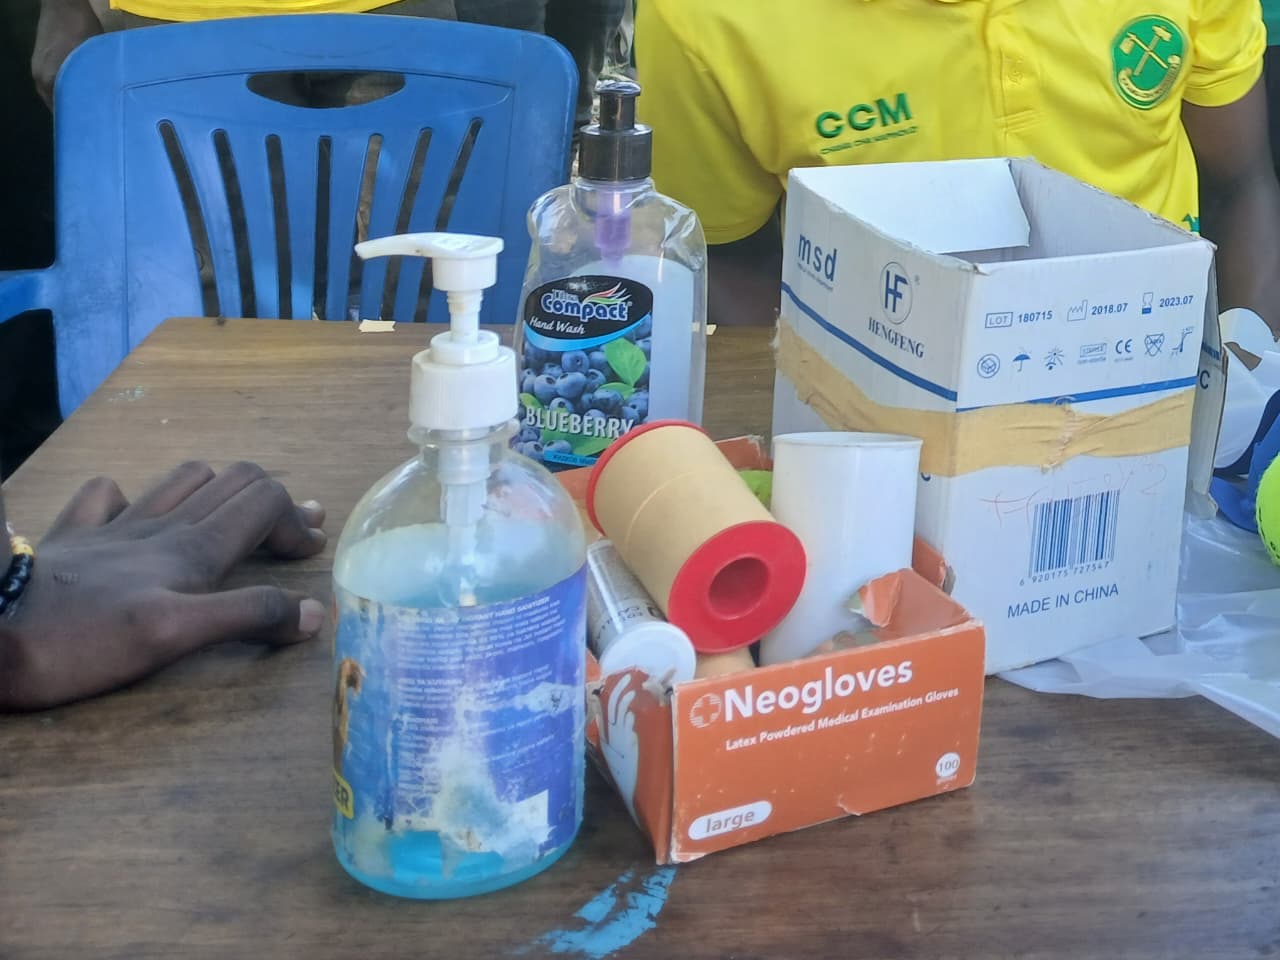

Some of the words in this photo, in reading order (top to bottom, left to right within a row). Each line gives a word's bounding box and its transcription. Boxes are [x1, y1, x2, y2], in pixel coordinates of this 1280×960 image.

[815, 92, 912, 139] CCM
[798, 234, 838, 282] msd
[541, 293, 628, 323] Compact
[1091, 302, 1129, 317] 2018.07
[1159, 295, 1194, 308] 2023.07
[530, 316, 554, 331] Hand
[556, 320, 586, 335] Wash
[988, 315, 1009, 326] LOT
[1018, 310, 1053, 324] 180715
[868, 316, 925, 359] HENGFENG
[526, 406, 634, 439] BLUEBERRY
[1007, 596, 1051, 619] MADE
[1055, 593, 1070, 608] IN
[1074, 582, 1119, 604] CHINA
[724, 660, 913, 723] Neogloves
[725, 737, 757, 751] Latex
[759, 720, 815, 742] Powdered
[817, 710, 859, 730] Medical
[861, 696, 923, 720] Examination
[925, 686, 960, 703] Gloves
[939, 759, 958, 772] 100
[706, 809, 756, 837] large
